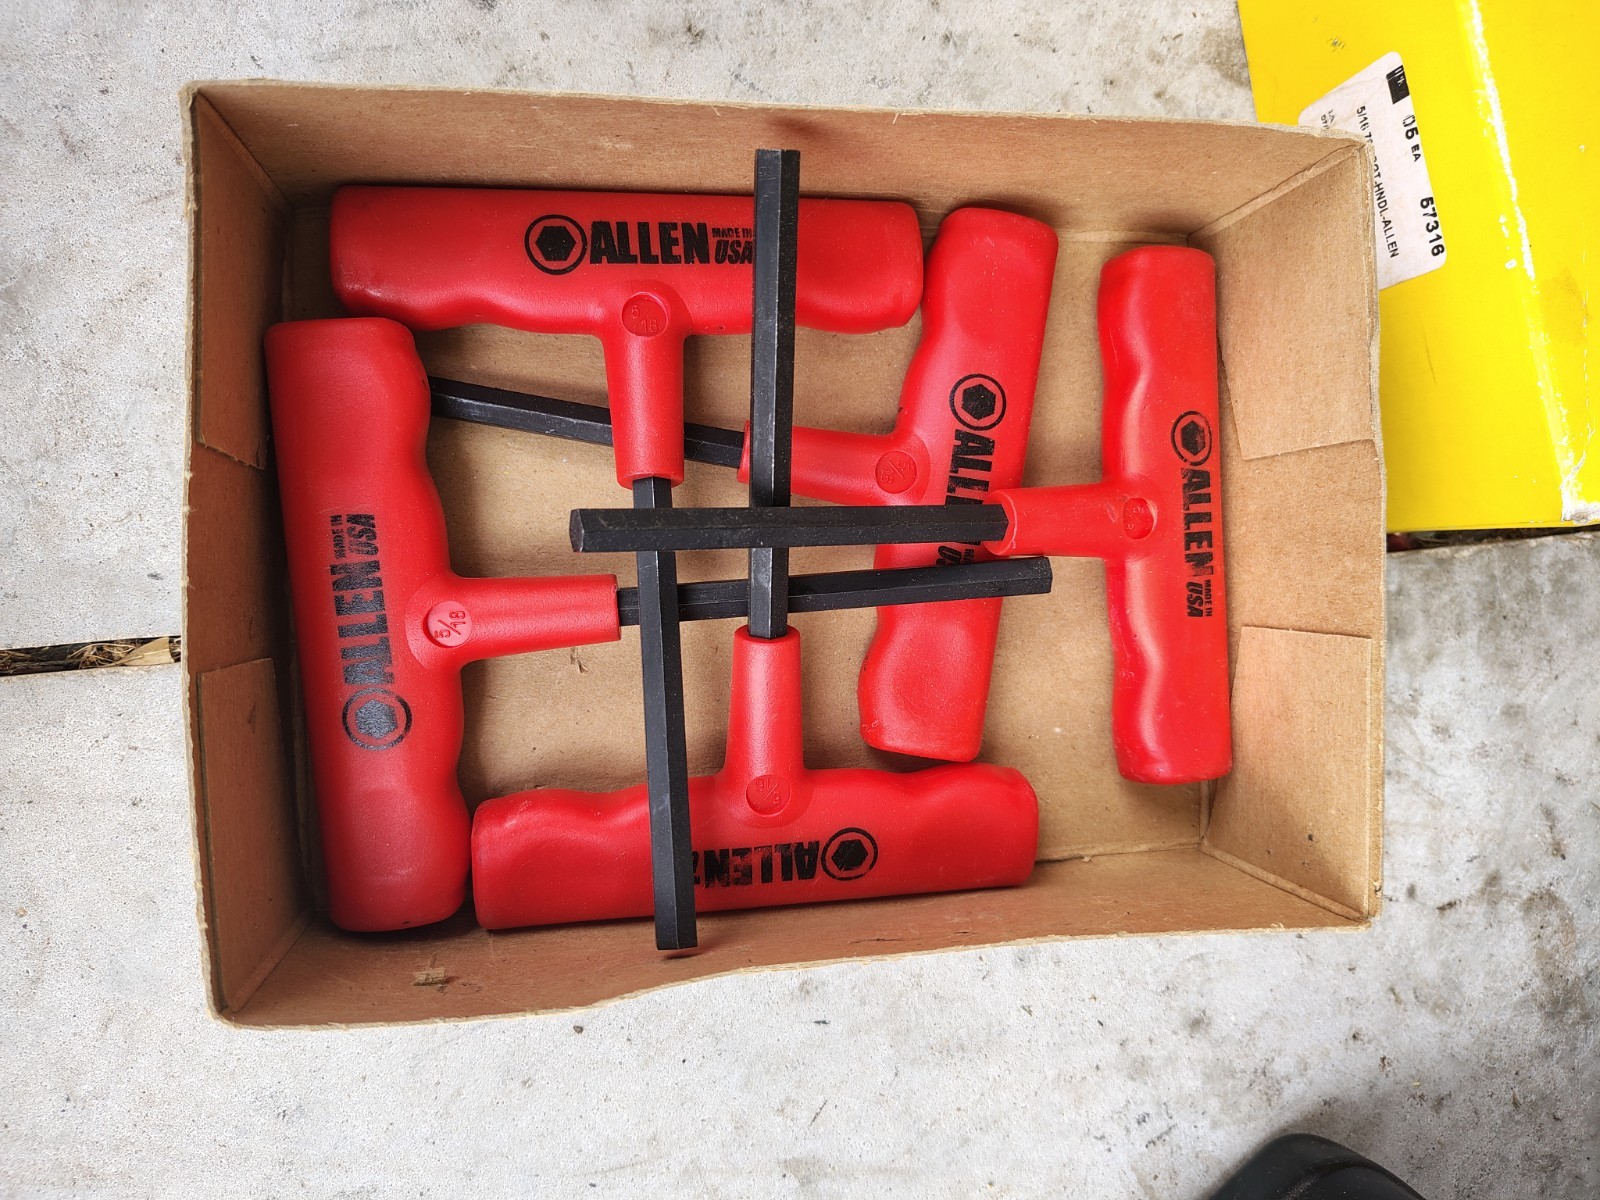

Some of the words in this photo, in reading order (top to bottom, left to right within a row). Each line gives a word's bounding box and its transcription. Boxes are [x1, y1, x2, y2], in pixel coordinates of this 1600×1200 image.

[1410, 146, 1422, 163] EA
[1420, 196, 1446, 257] 57316
[590, 220, 710, 264] ALLEN
[711, 227, 741, 239] MADE
[714, 239, 754, 265] USA
[330, 514, 342, 526] IN
[345, 513, 380, 557] USA
[1180, 467, 1214, 578] ALLEN
[331, 527, 346, 559] MADE
[1185, 581, 1204, 618] USA
[1204, 579, 1212, 606] MADE
[329, 559, 395, 686] ALLEN
[433, 610, 467, 640] 5/16
[1205, 607, 1213, 617] IN
[703, 840, 820, 889] ALLEN
